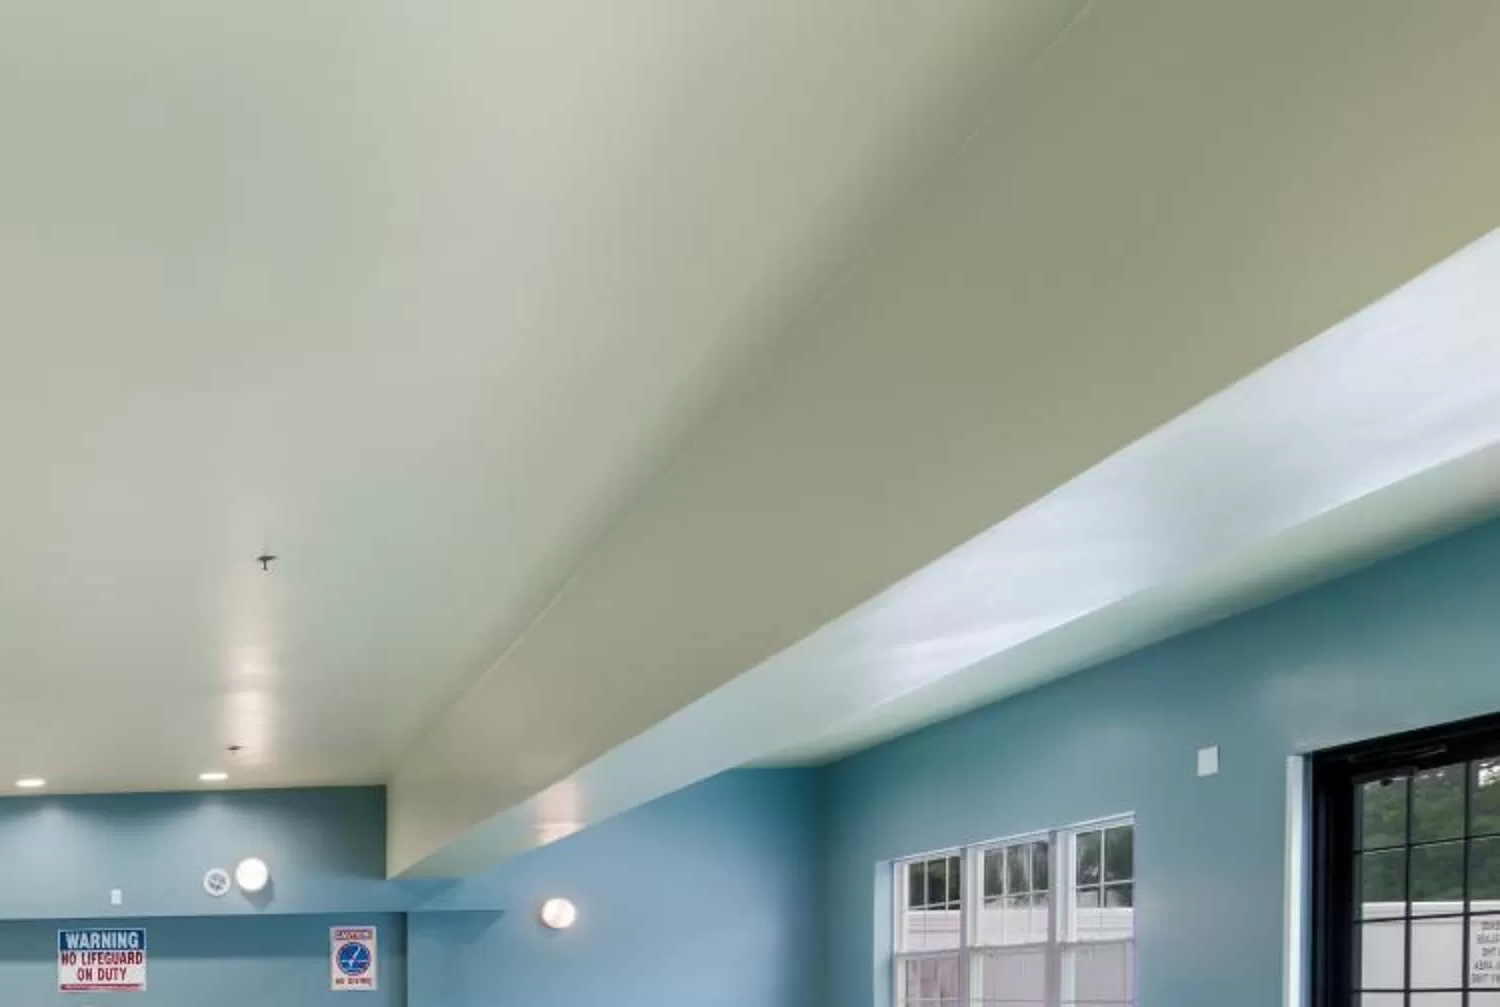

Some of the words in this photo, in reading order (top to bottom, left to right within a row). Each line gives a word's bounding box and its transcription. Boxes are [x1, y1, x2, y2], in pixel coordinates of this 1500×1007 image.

[65, 931, 139, 949] WARNING
[61, 952, 77, 965] NO
[81, 951, 143, 965] LIFEGUARD
[77, 967, 93, 981] ON
[98, 967, 127, 981] DUTY
